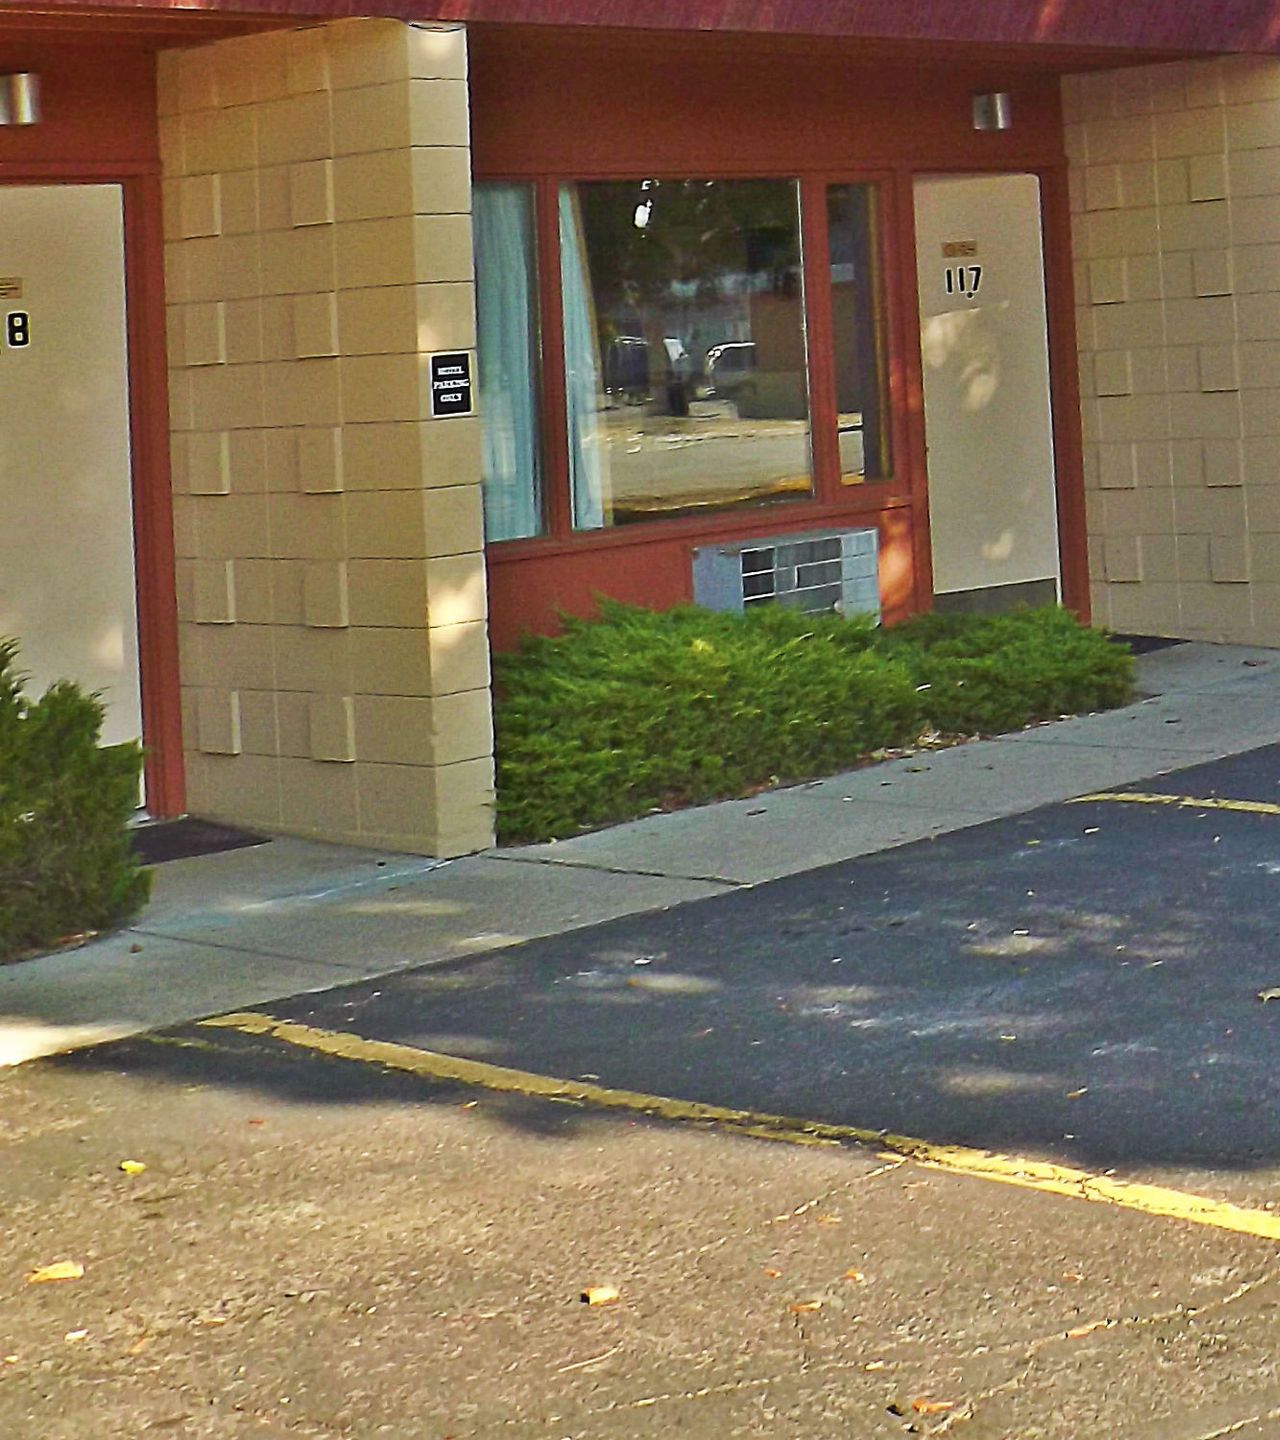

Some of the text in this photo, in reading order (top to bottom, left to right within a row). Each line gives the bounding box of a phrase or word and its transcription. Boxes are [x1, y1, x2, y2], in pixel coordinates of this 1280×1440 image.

[946, 266, 982, 293] 117
[7, 312, 30, 347] 8
[433, 379, 470, 389] PARKING
[440, 393, 462, 402] ONLY
